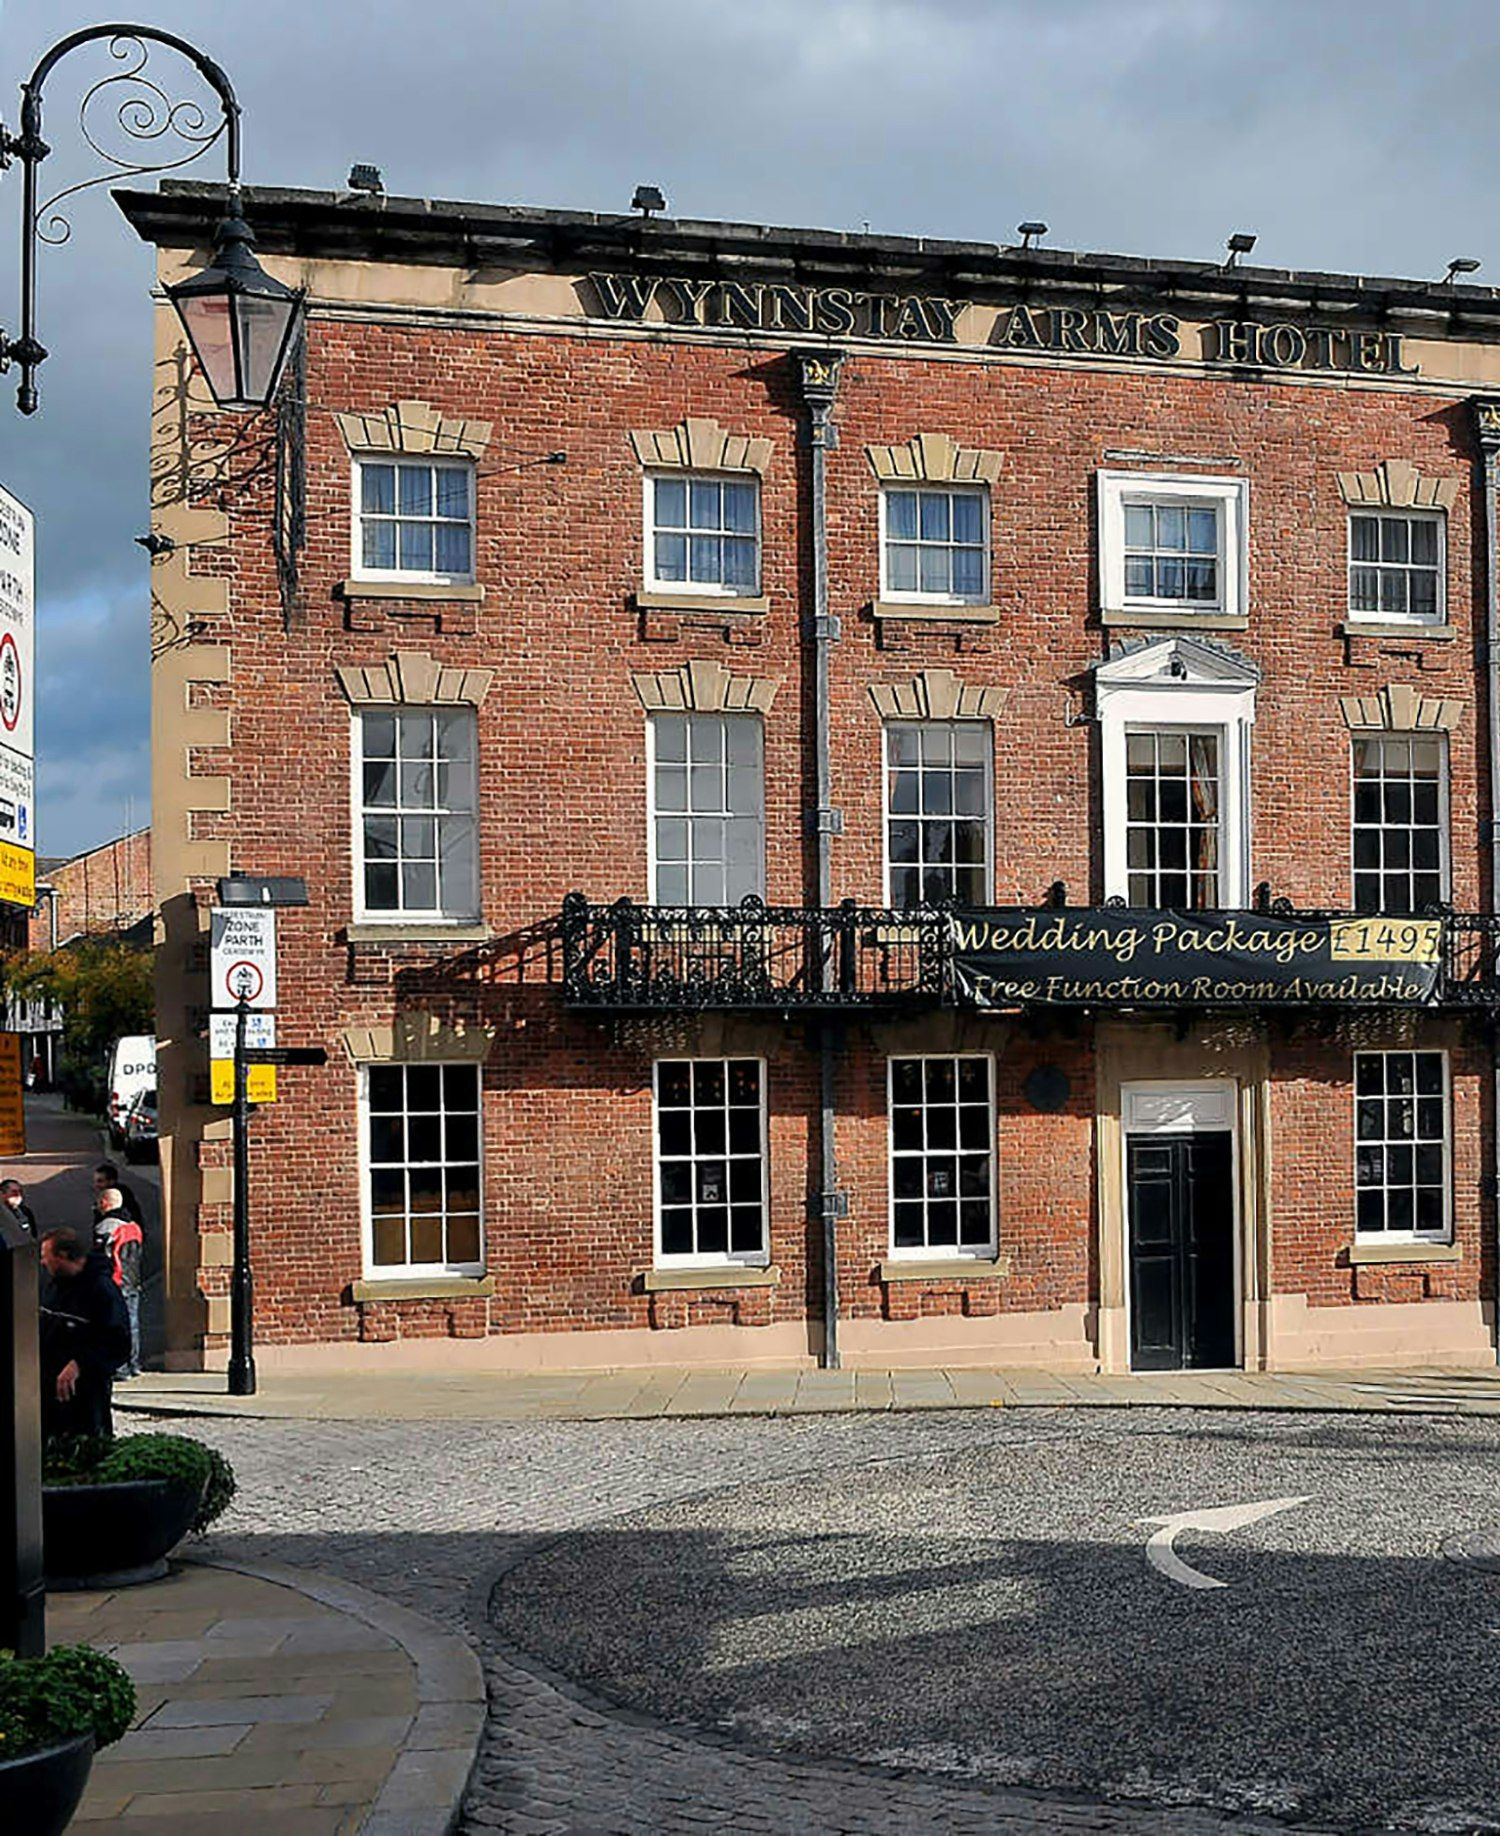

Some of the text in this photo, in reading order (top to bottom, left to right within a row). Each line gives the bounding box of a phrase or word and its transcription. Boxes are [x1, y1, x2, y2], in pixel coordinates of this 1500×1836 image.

[589, 271, 1420, 376] WYNNSTAY ARMS HOTEL
[226, 919, 260, 933] ZONE
[225, 934, 264, 946] PARTH
[955, 917, 1439, 963] Wedding Package £1495
[974, 975, 1426, 1001] Free Function Room Available
